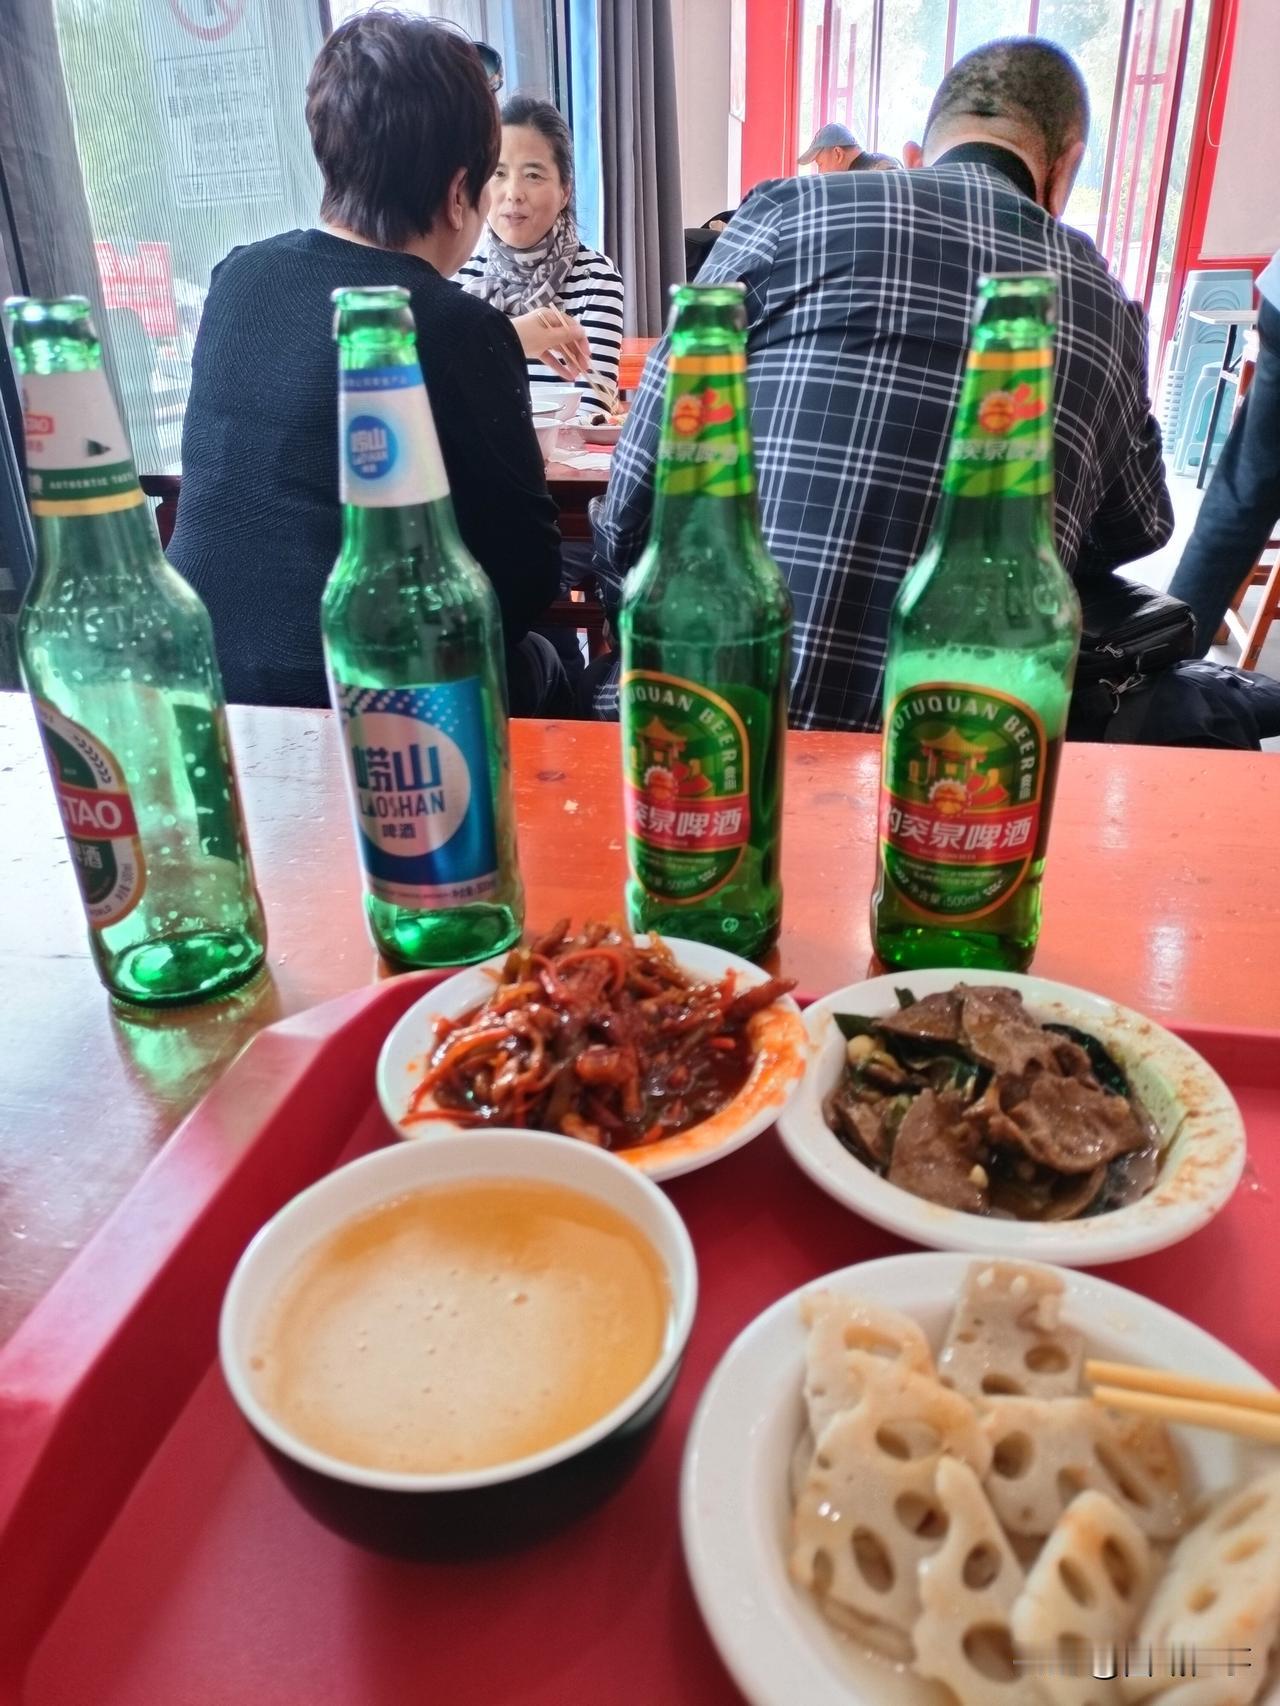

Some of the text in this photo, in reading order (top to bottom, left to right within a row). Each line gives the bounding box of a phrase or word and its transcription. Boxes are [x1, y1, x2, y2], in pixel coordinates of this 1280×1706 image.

[699, 708, 738, 762] BEER
[892, 695, 1035, 771] OTUQUAN BEER
[360, 790, 446, 818] LAOSHAN
